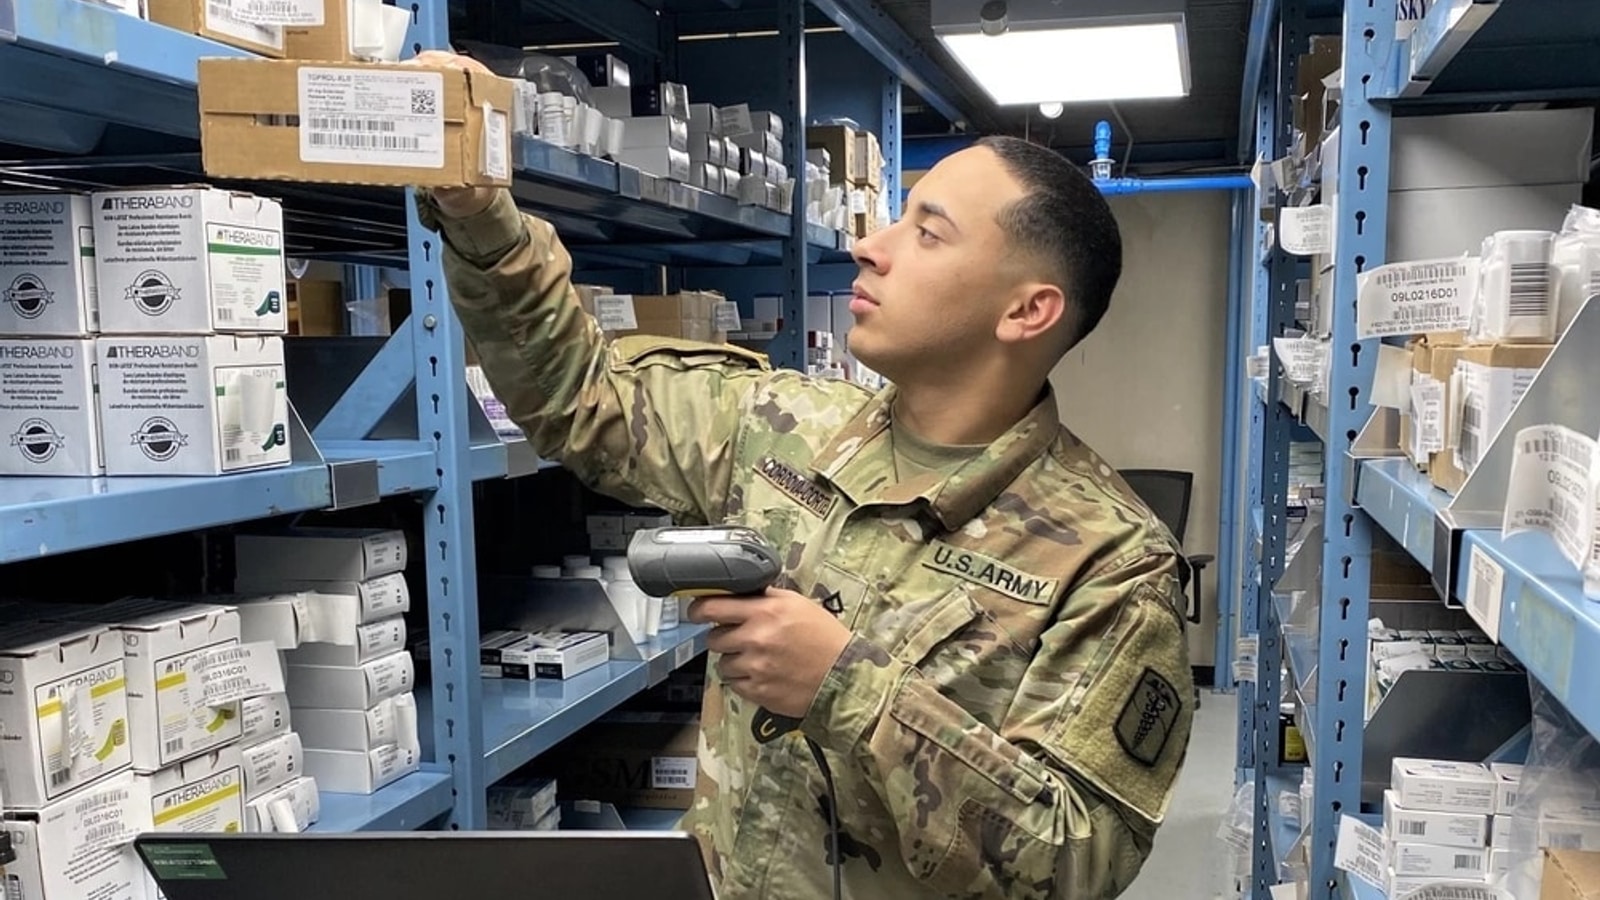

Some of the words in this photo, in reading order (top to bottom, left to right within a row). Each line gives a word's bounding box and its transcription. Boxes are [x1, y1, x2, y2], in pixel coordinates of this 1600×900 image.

[112, 195, 193, 210] THERABAND
[223, 229, 274, 246] THERABAND
[1391, 288, 1458, 303] 09L0216D01
[117, 345, 199, 359] THERABAND
[171, 774, 232, 806] THERABAND
